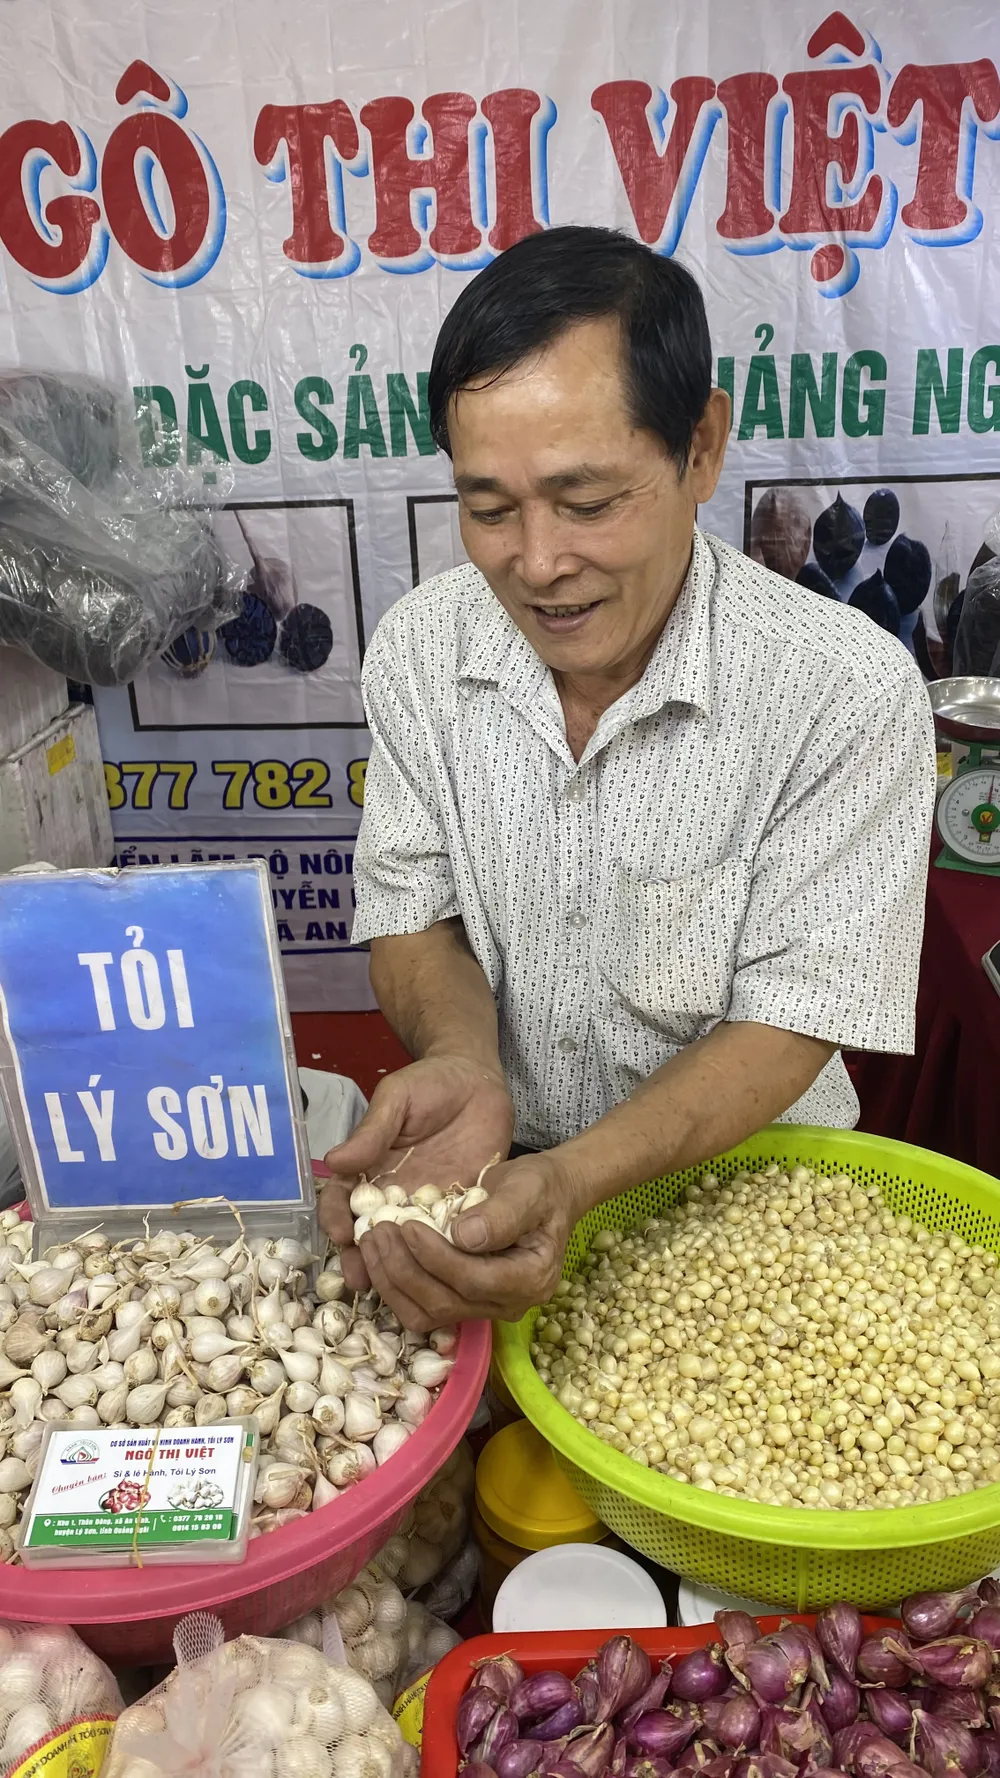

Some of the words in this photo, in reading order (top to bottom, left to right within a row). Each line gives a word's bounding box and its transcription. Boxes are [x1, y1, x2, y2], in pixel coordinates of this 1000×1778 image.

[0, 58, 222, 290] GÔ
[590, 11, 1000, 294] VIỆT
[294, 344, 437, 462] SẢN
[211, 758, 333, 810] 782
[305, 921, 348, 940] AN
[78, 926, 194, 1031] TỎI
[44, 1075, 116, 1163] LÝ
[147, 1075, 274, 1161] SƠN
[125, 1448, 154, 1460] NGÔ
[159, 1449, 180, 1461] THỊ
[185, 1446, 215, 1460] VIỆT
[186, 1468, 196, 1476] Lý
